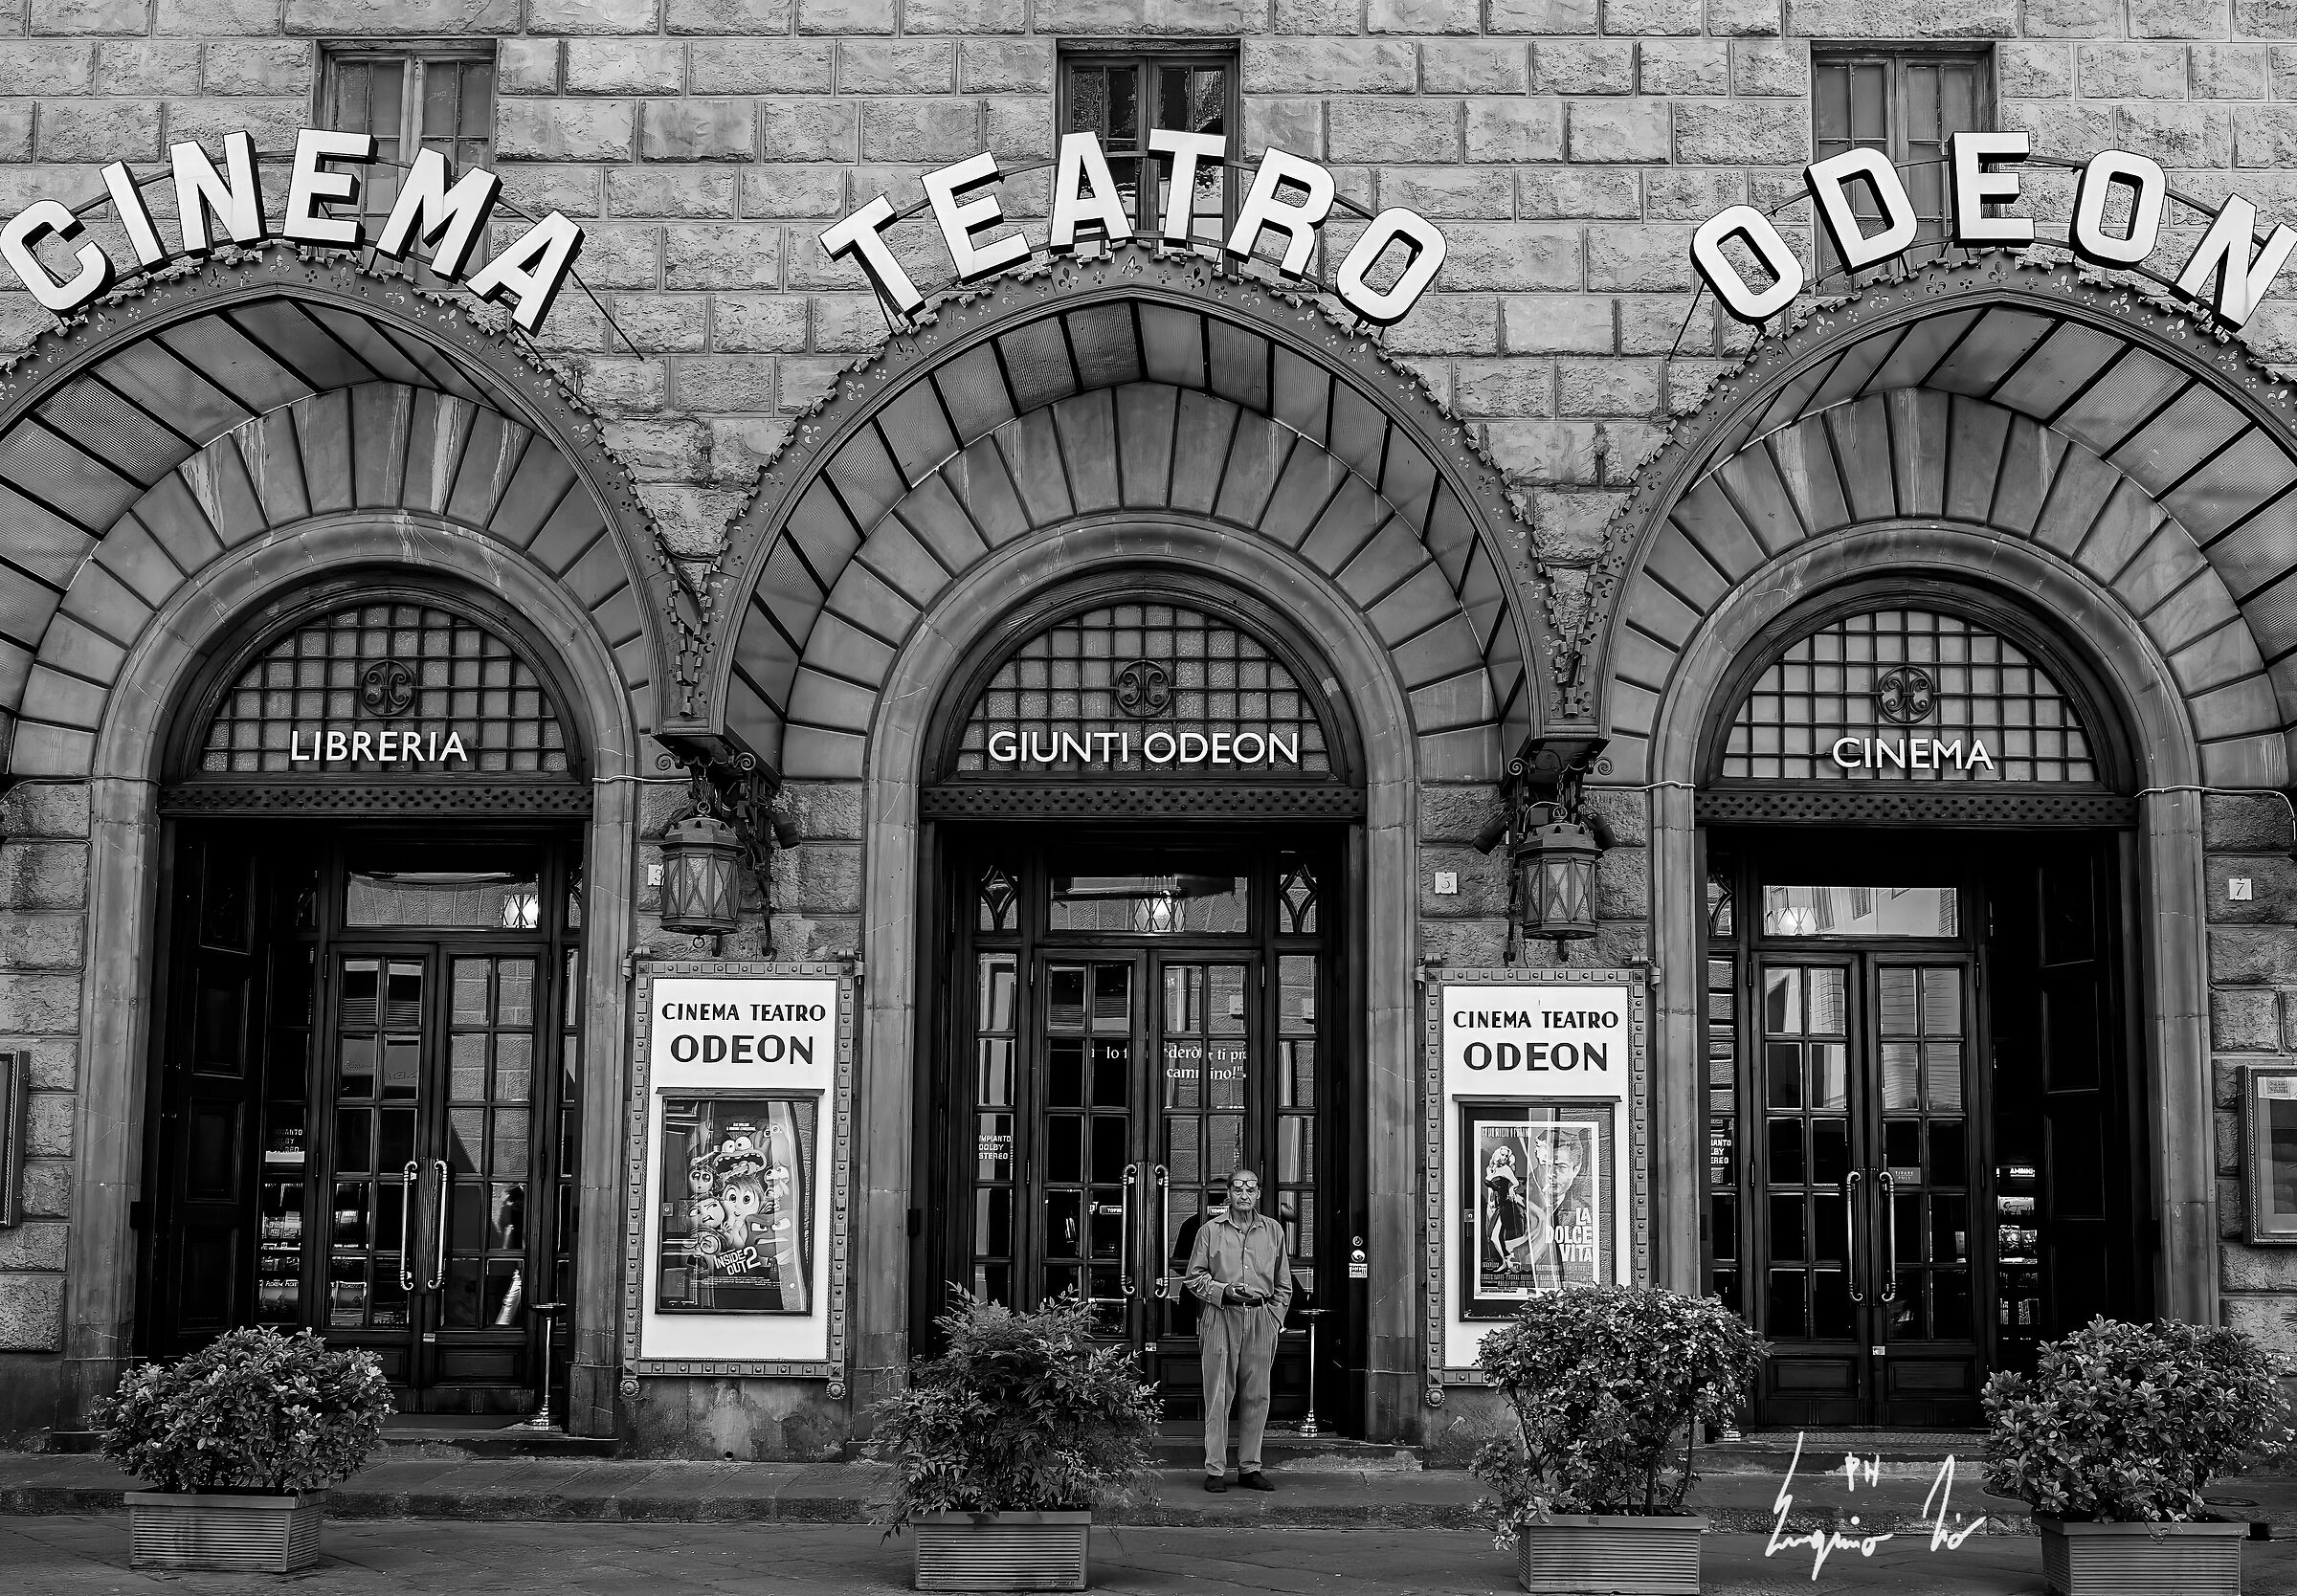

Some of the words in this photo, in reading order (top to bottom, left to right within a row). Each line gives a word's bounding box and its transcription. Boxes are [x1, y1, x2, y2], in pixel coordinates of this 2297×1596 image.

[0, 128, 585, 336] CINEMA
[819, 128, 1448, 327] TEATRO
[1689, 131, 2297, 327] ODEON
[290, 730, 469, 762] LIBRERIA
[988, 730, 1129, 763] GIUNTI
[1144, 731, 1299, 764] ODEON
[1832, 737, 1996, 771] CINEMA
[2236, 881, 2245, 897] 7
[661, 1003, 740, 1021] CINEMA
[750, 1004, 826, 1022] TEATRO
[1453, 1010, 1531, 1029] CINEMA
[1541, 1010, 1619, 1029] TEATRO
[670, 1033, 814, 1065] ODEON
[1217, 1048, 1227, 1060] ti
[1463, 1041, 1608, 1072] ODEON
[1575, 1207, 1592, 1225] LA
[1545, 1225, 1593, 1244] DOLCE
[714, 1249, 747, 1270] INSIDE
[744, 1246, 762, 1270] 2
[1559, 1244, 1593, 1262] VITA
[727, 1259, 747, 1276] OUT
